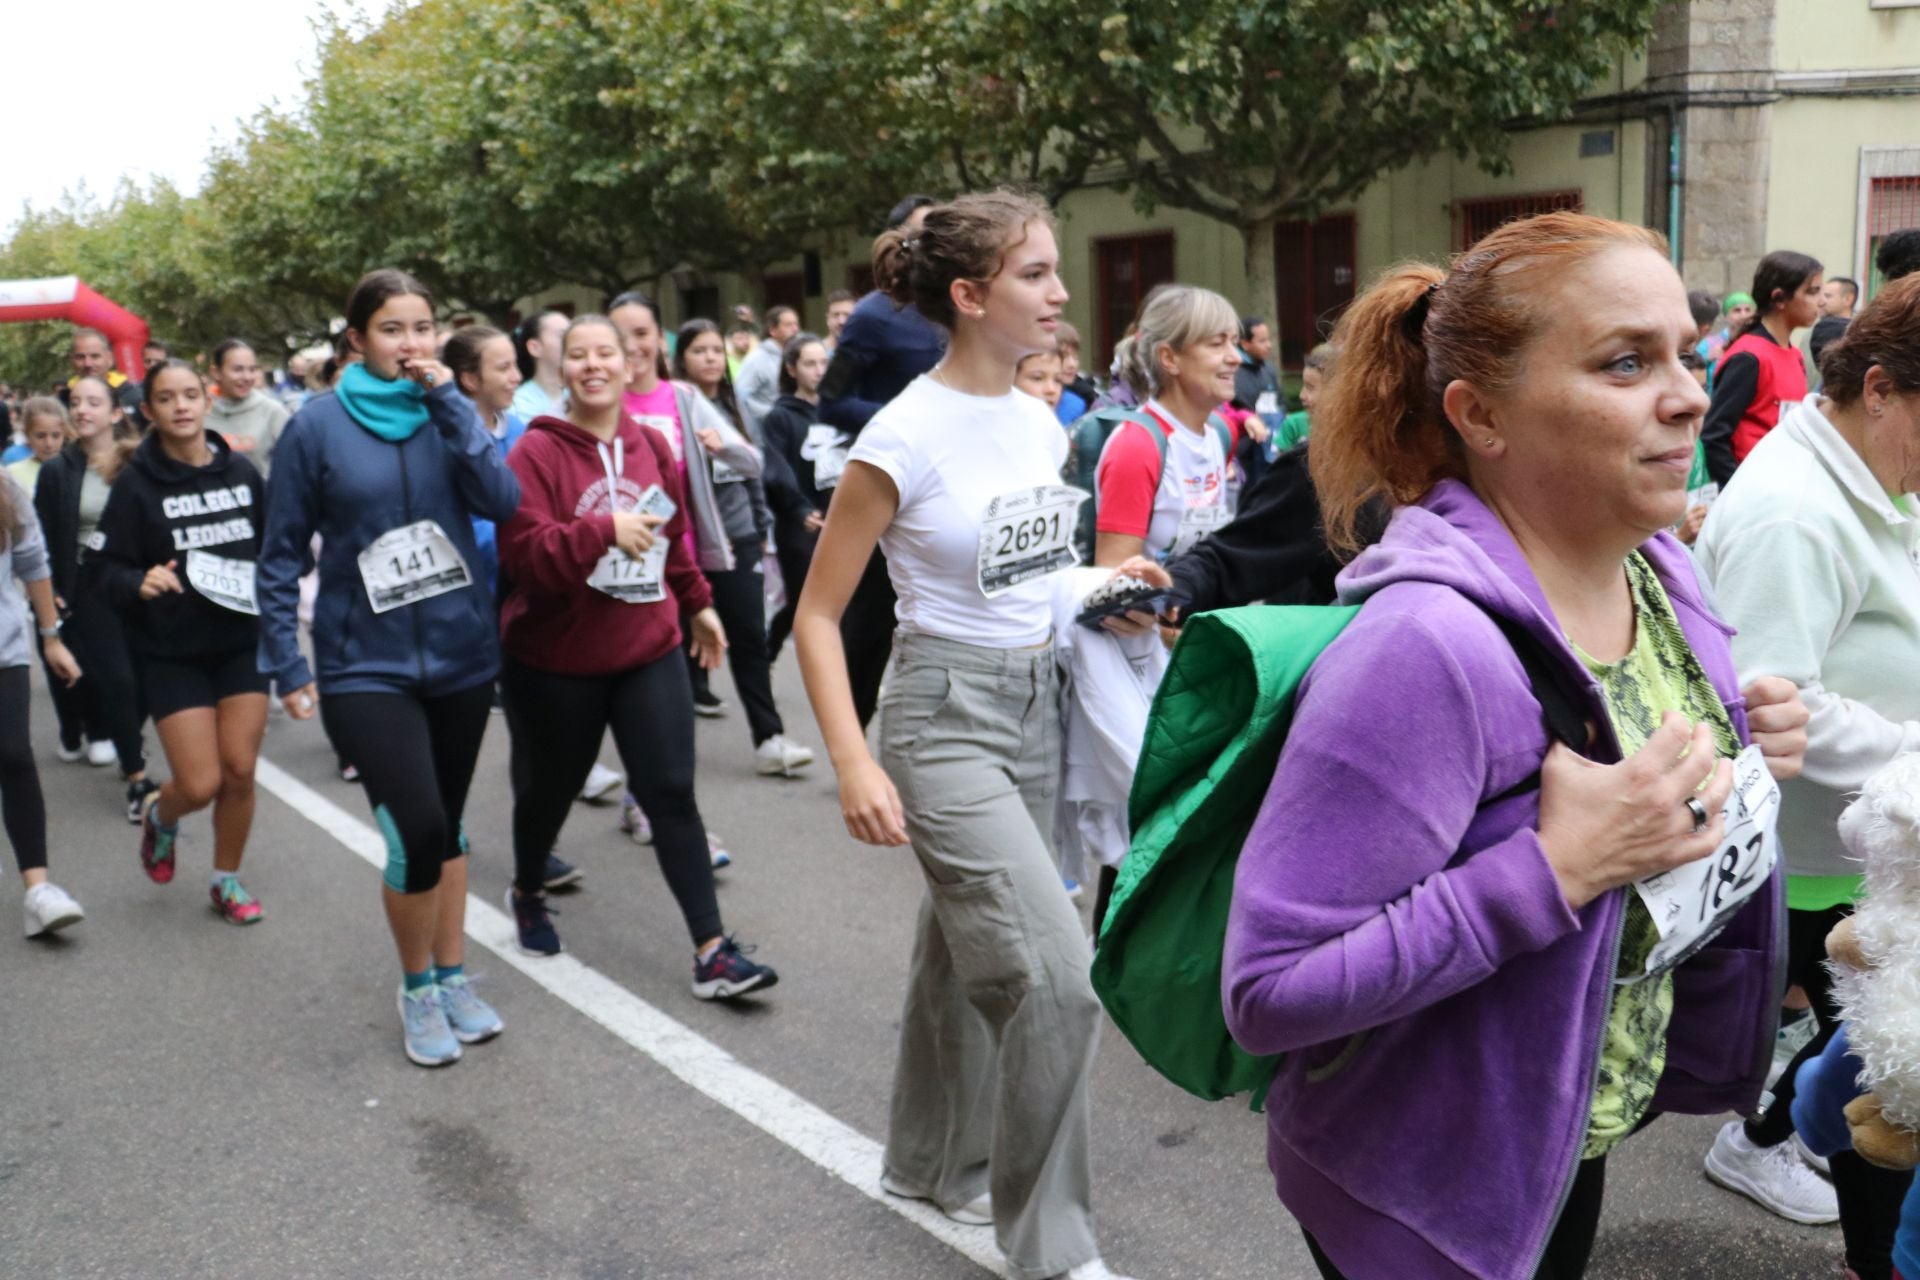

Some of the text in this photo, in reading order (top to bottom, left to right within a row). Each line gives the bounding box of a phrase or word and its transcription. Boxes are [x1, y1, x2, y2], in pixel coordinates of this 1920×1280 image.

[995, 512, 1060, 557] 2691
[388, 546, 436, 578] 141
[608, 558, 647, 579] 172
[198, 569, 243, 593] 2703
[1698, 831, 1764, 923] 182
